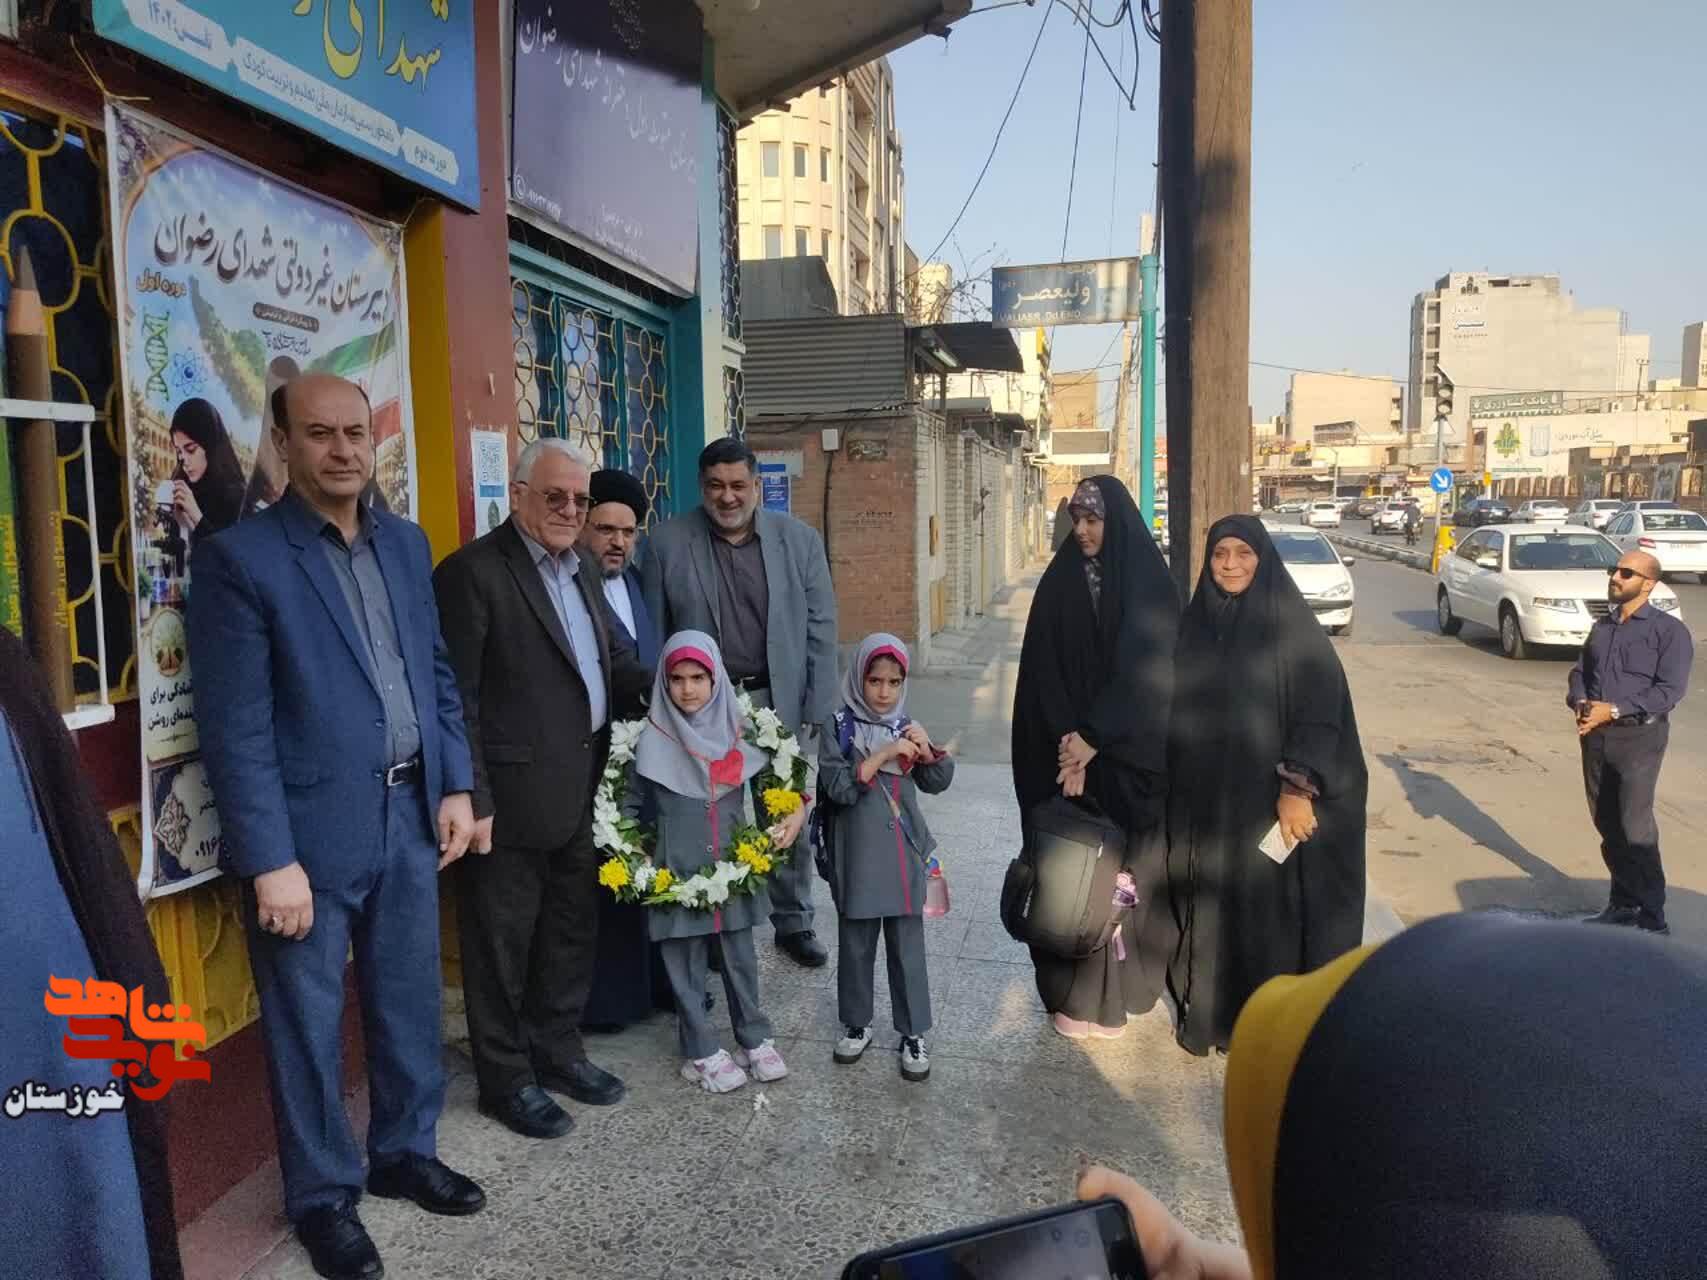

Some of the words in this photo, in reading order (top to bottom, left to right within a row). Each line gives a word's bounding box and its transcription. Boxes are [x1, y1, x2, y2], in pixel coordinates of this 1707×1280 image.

[518, 4, 562, 66] رضوان
[563, 47, 602, 88] شهدای
[154, 211, 219, 266] رضوان
[217, 223, 276, 282] شهدای
[136, 266, 160, 293] اول
[1010, 279, 1091, 311] ولیعصر
[150, 686, 166, 705] برای
[148, 711, 169, 731] روشن
